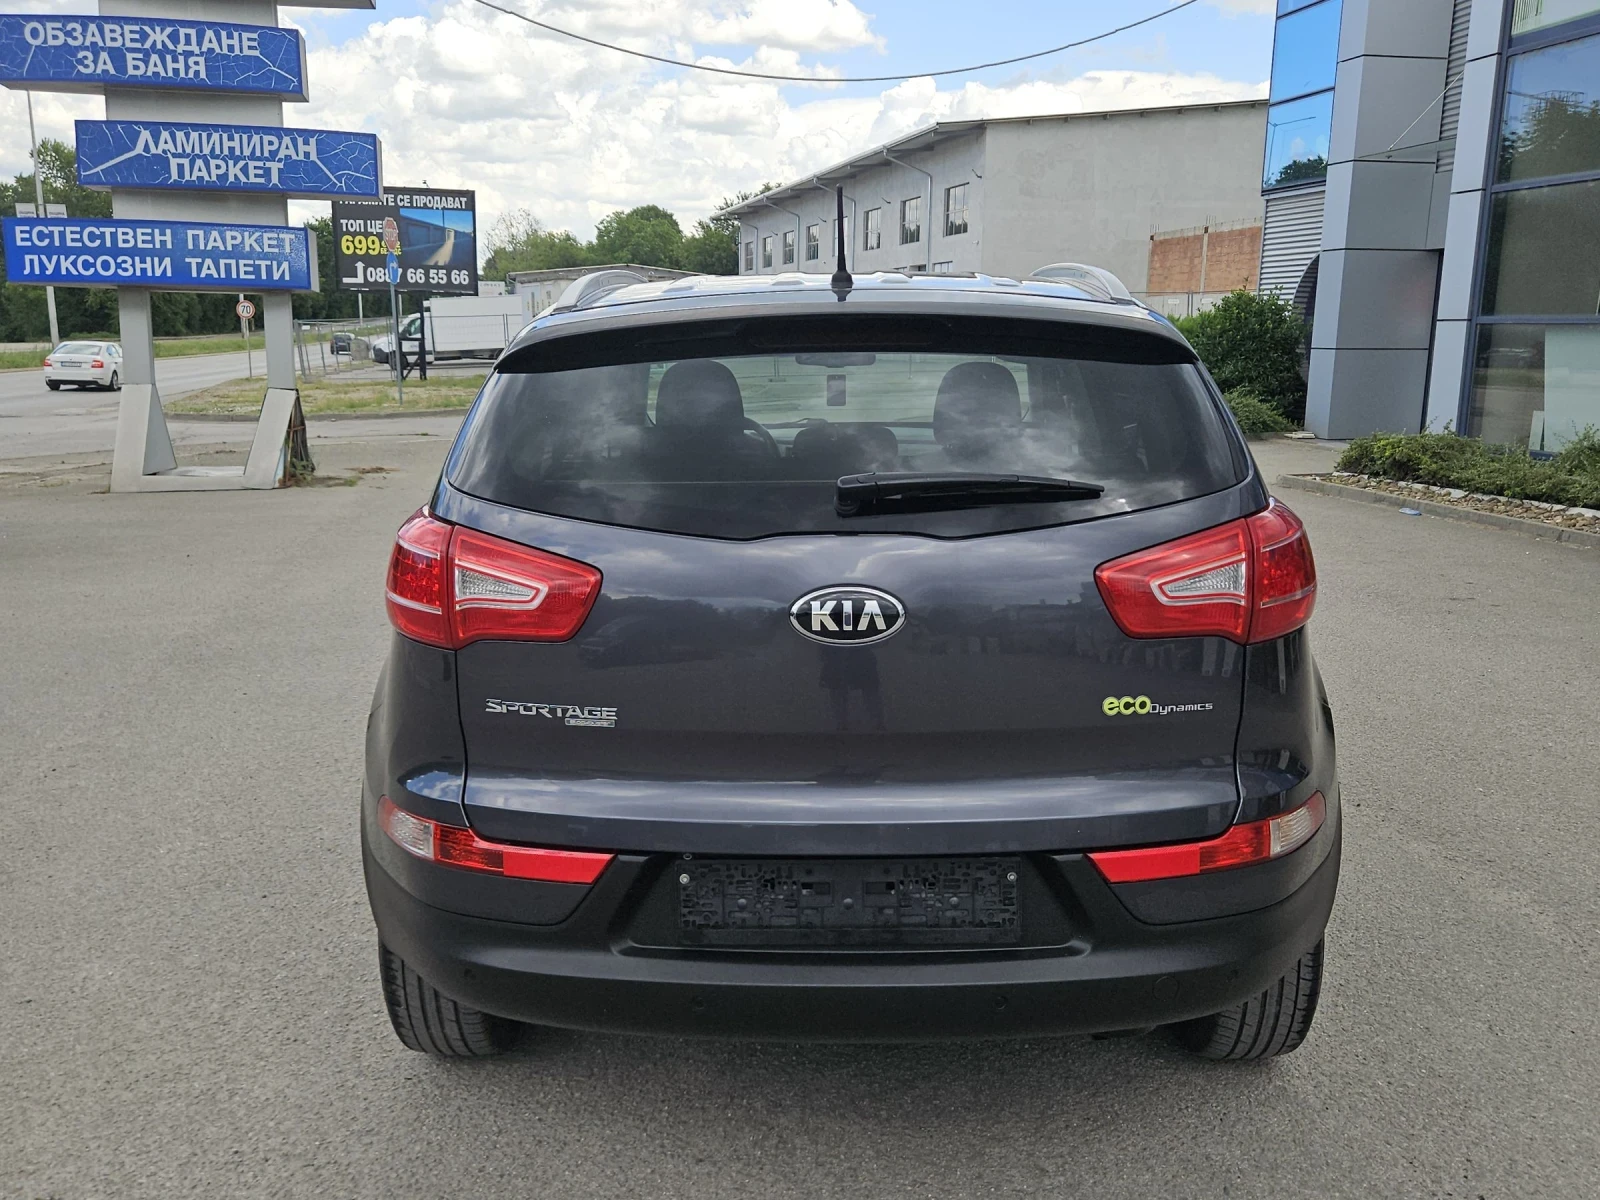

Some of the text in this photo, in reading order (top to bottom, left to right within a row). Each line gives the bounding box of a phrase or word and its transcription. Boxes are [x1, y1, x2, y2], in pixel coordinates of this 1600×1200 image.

[24, 21, 260, 56] ОБЗАВЕЖДАНЕ
[77, 51, 207, 79] ЗА БАНЯ
[135, 130, 317, 161] ЛАМИНИРАН
[169, 157, 284, 184] ПАРКЕТ
[396, 194, 410, 207] СЕ
[413, 195, 467, 209] ПРОДАВАТ
[15, 225, 295, 253] ЕСТЕСТВЕН ПАРКЕТ
[340, 219, 365, 232] ТОП
[341, 234, 380, 255] 699
[23, 254, 291, 281] ЛУКСОЗНИ ТАПЕТИ
[407, 269, 426, 284] 66
[429, 269, 447, 284] 55
[451, 269, 469, 285] 66
[240, 305, 251, 314] 70
[810, 600, 887, 631] KIA
